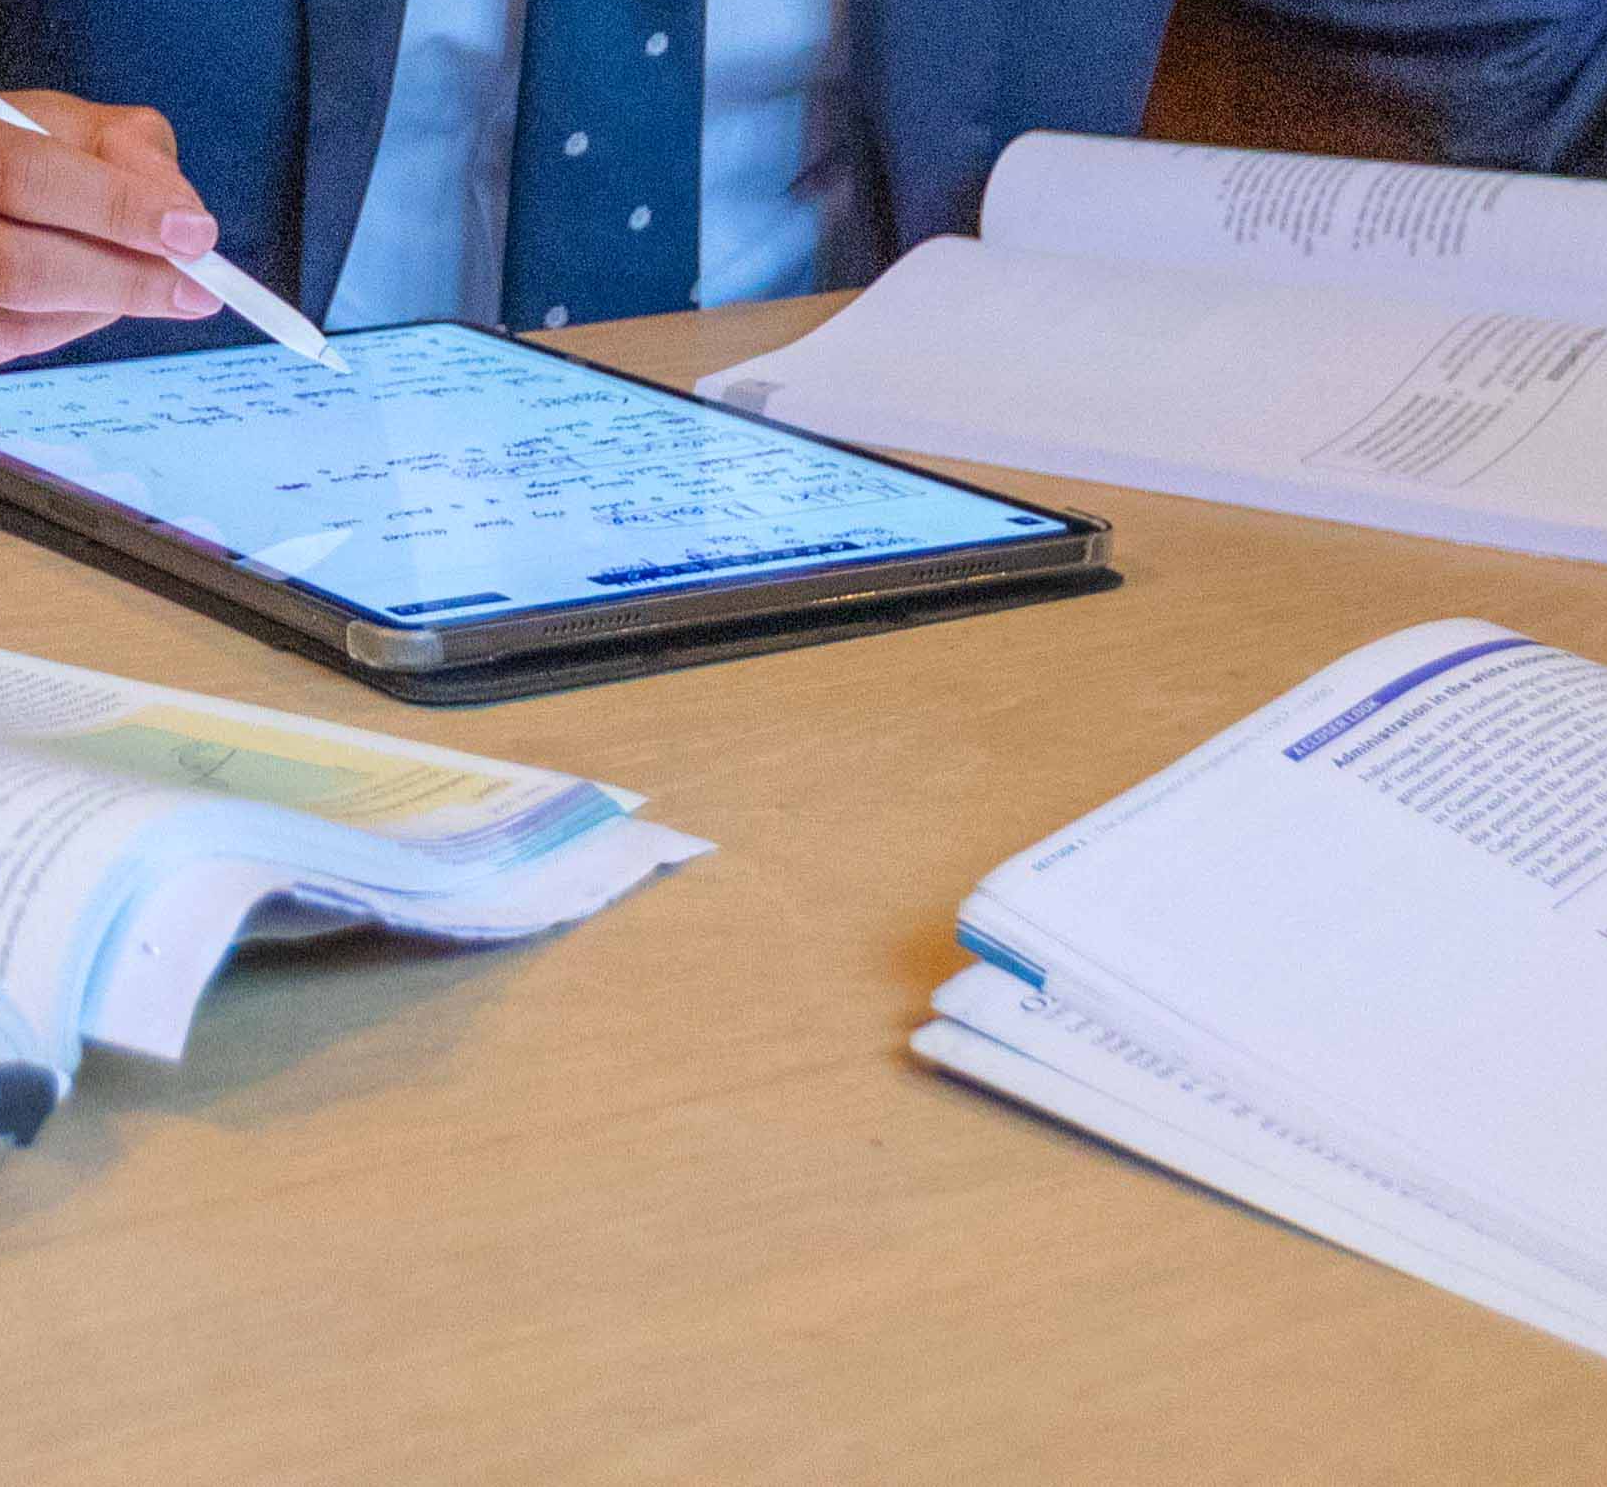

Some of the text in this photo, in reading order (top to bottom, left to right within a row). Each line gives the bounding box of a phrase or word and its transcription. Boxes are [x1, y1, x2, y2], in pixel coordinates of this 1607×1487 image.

[1306, 716, 1348, 752] CLOSER
[1351, 697, 1380, 723] LOOK
[1333, 665, 1508, 768] Administration in the white
[1359, 745, 1422, 782] Following
[1414, 732, 1436, 747] the
[1397, 764, 1464, 806] governors
[1451, 740, 1485, 767] ruled
[1483, 727, 1510, 745] with
[1507, 716, 1529, 729] the
[1467, 759, 1493, 777] who
[1493, 736, 1526, 760] could
[1485, 792, 1509, 812] and
[1519, 767, 1548, 786] New
[1547, 737, 1595, 768] Zealand
[1444, 783, 1492, 814] Canada
[1490, 774, 1505, 785] in
[1502, 761, 1524, 776] the
[1468, 830, 1492, 846] the
[1532, 787, 1548, 802] of
[1544, 777, 1566, 792] the
[1508, 825, 1563, 866] remained
[1562, 802, 1596, 829] under
[1517, 803, 1563, 834] Colony
